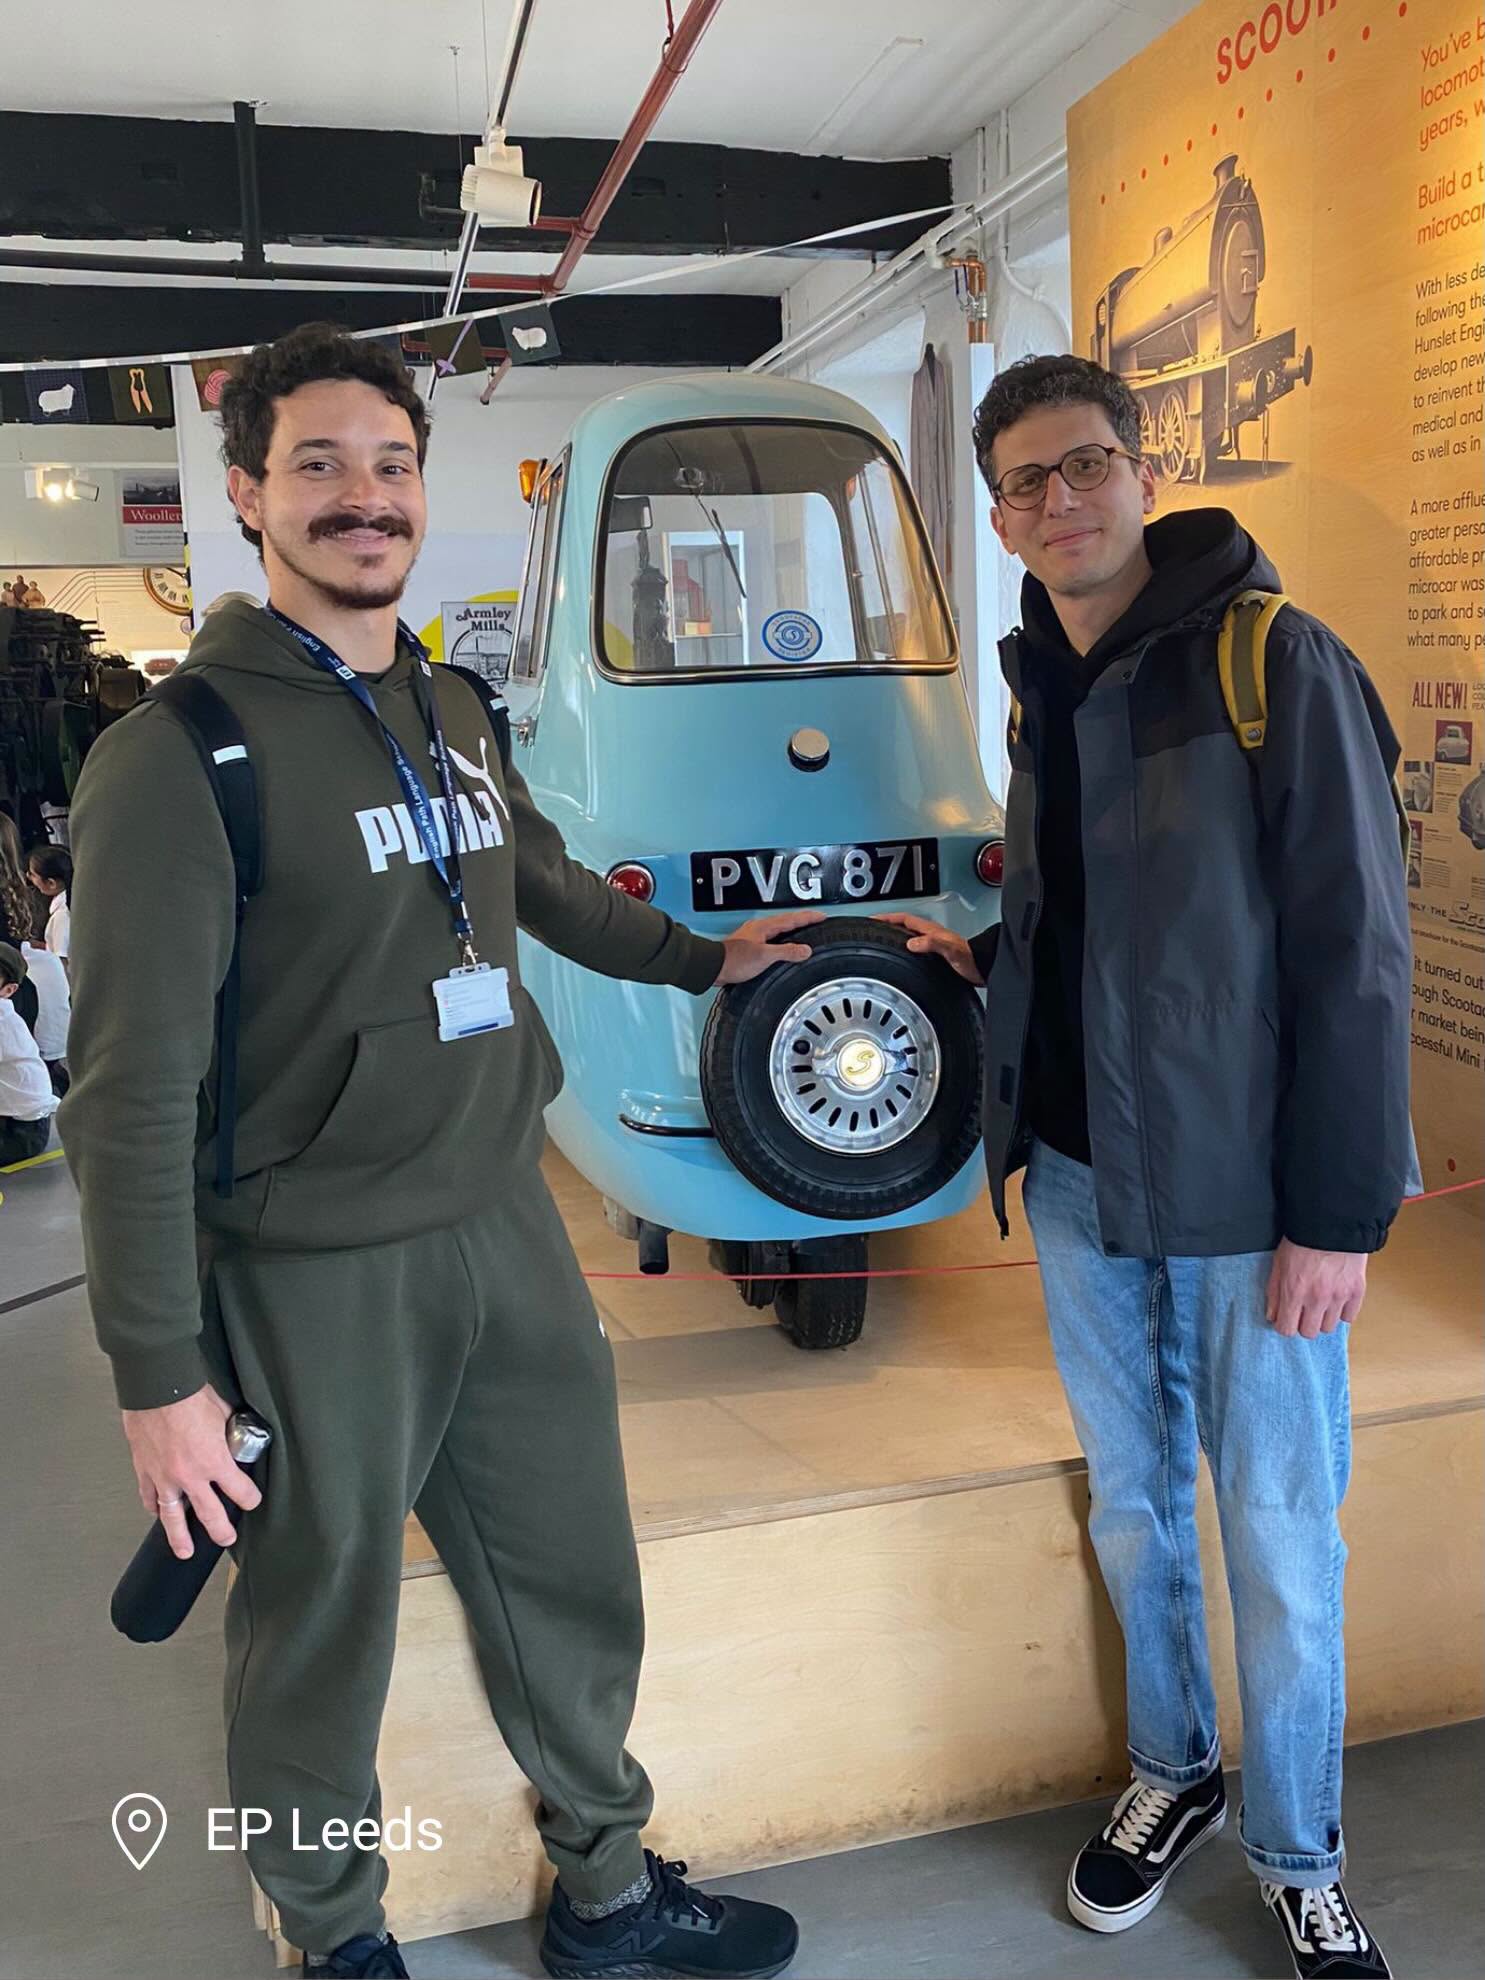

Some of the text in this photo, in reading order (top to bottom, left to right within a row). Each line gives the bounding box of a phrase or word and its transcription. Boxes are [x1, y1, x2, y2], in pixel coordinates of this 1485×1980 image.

[1217, 0, 1338, 84] SCOO
[1421, 31, 1471, 72] You've
[1419, 109, 1468, 151] years,
[1418, 170, 1456, 209] Build
[1461, 171, 1472, 190] a
[1416, 279, 1442, 299] With
[1445, 271, 1467, 290] less
[1415, 301, 1466, 327] following
[1414, 329, 1456, 354] Hunslet
[1413, 359, 1457, 381] develop
[1413, 393, 1424, 409] to
[1427, 382, 1472, 405] reinvent
[1412, 404, 1483, 435] medical and
[1411, 435, 1481, 462] as well as in
[1410, 499, 1418, 515] A
[1421, 499, 1450, 514] more
[1409, 526, 1450, 546] greater
[1409, 548, 1468, 568] affordable
[1408, 578, 1485, 595] microcar was
[456, 607, 512, 621] Armley
[471, 620, 505, 631] Mills
[1408, 607, 1418, 621] to
[1422, 603, 1447, 624] park
[1450, 602, 1473, 619] and
[1407, 630, 1434, 647] what
[1438, 634, 1470, 651] many
[1411, 681, 1468, 710] ALL NEW!
[711, 845, 924, 905] PVG 871
[1414, 956, 1485, 991] it turned out
[1418, 1012, 1457, 1034] market
[1456, 1044, 1480, 1069] Mini
